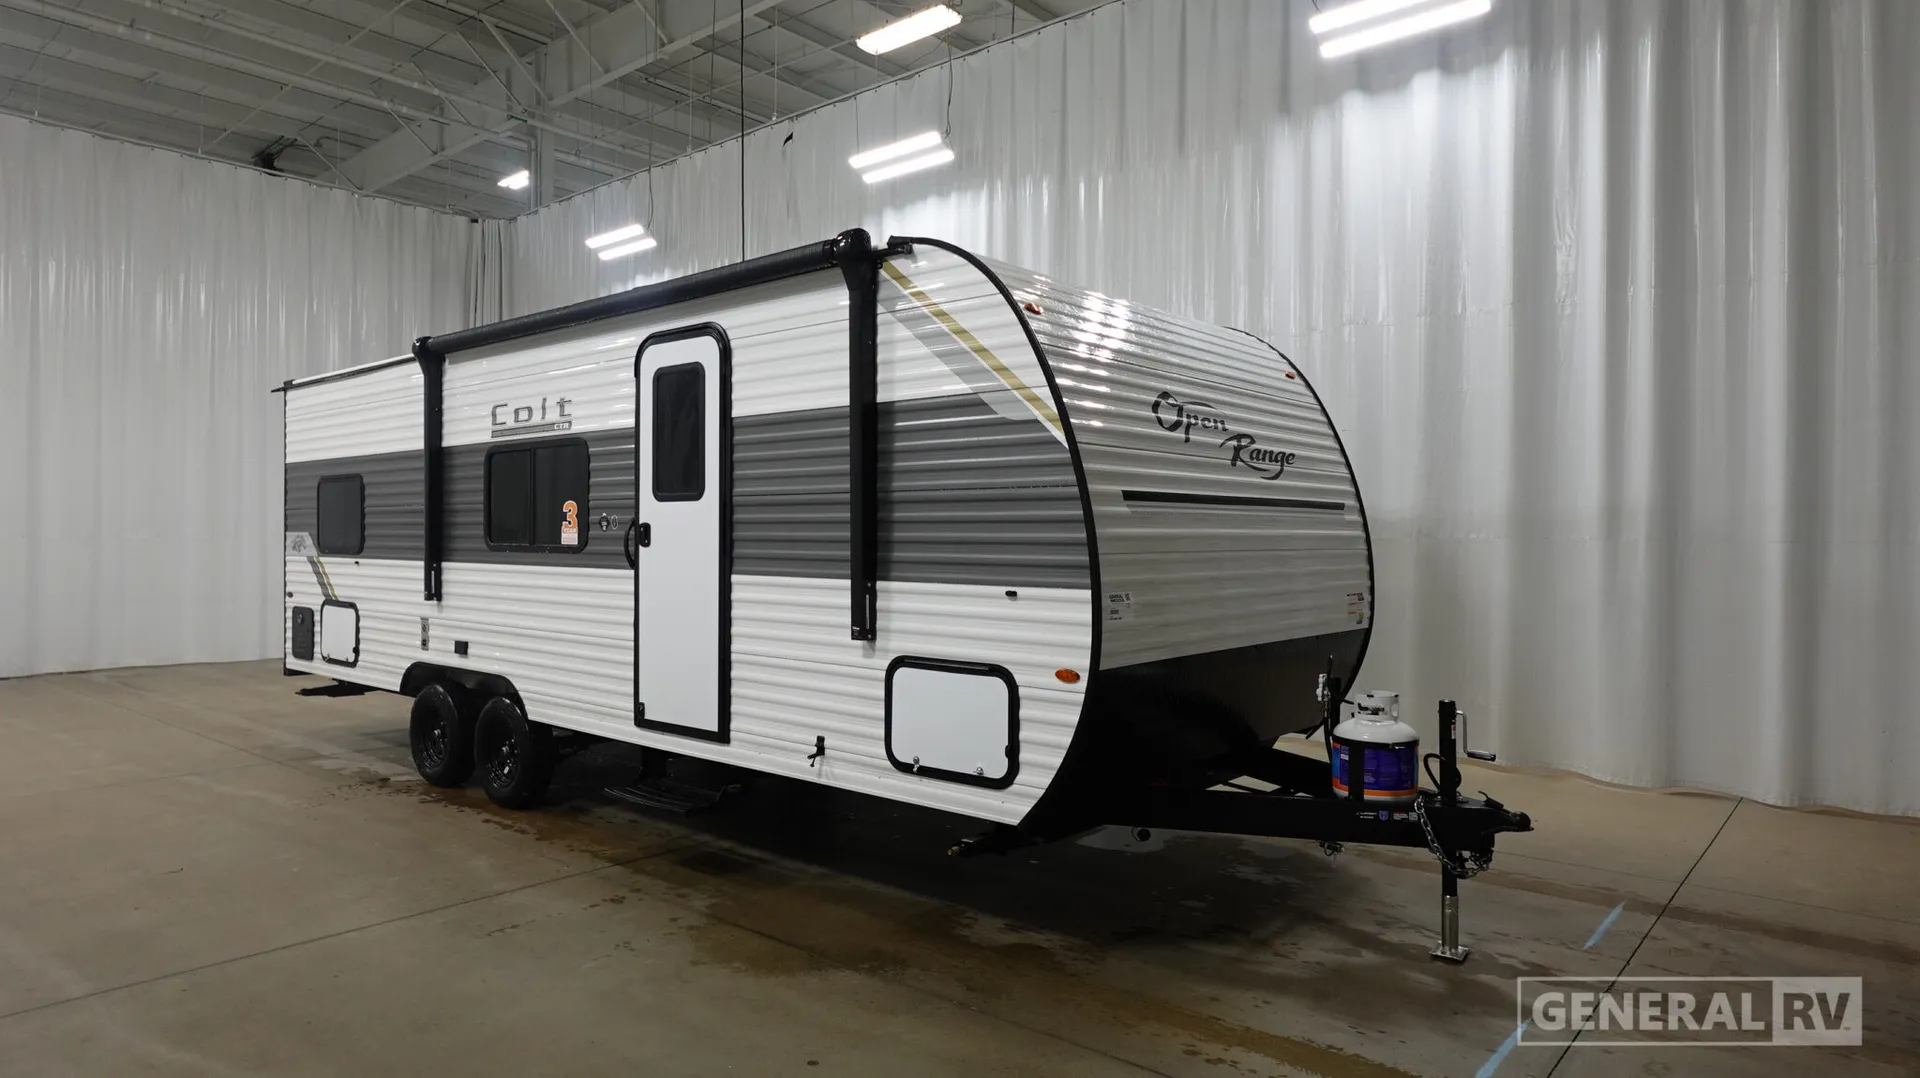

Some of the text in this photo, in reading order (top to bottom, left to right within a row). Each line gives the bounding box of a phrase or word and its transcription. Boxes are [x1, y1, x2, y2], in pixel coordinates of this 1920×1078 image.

[491, 397, 572, 426] Colt
[1152, 391, 1229, 443] Open
[1219, 433, 1296, 480] Range
[563, 500, 578, 529] 3
